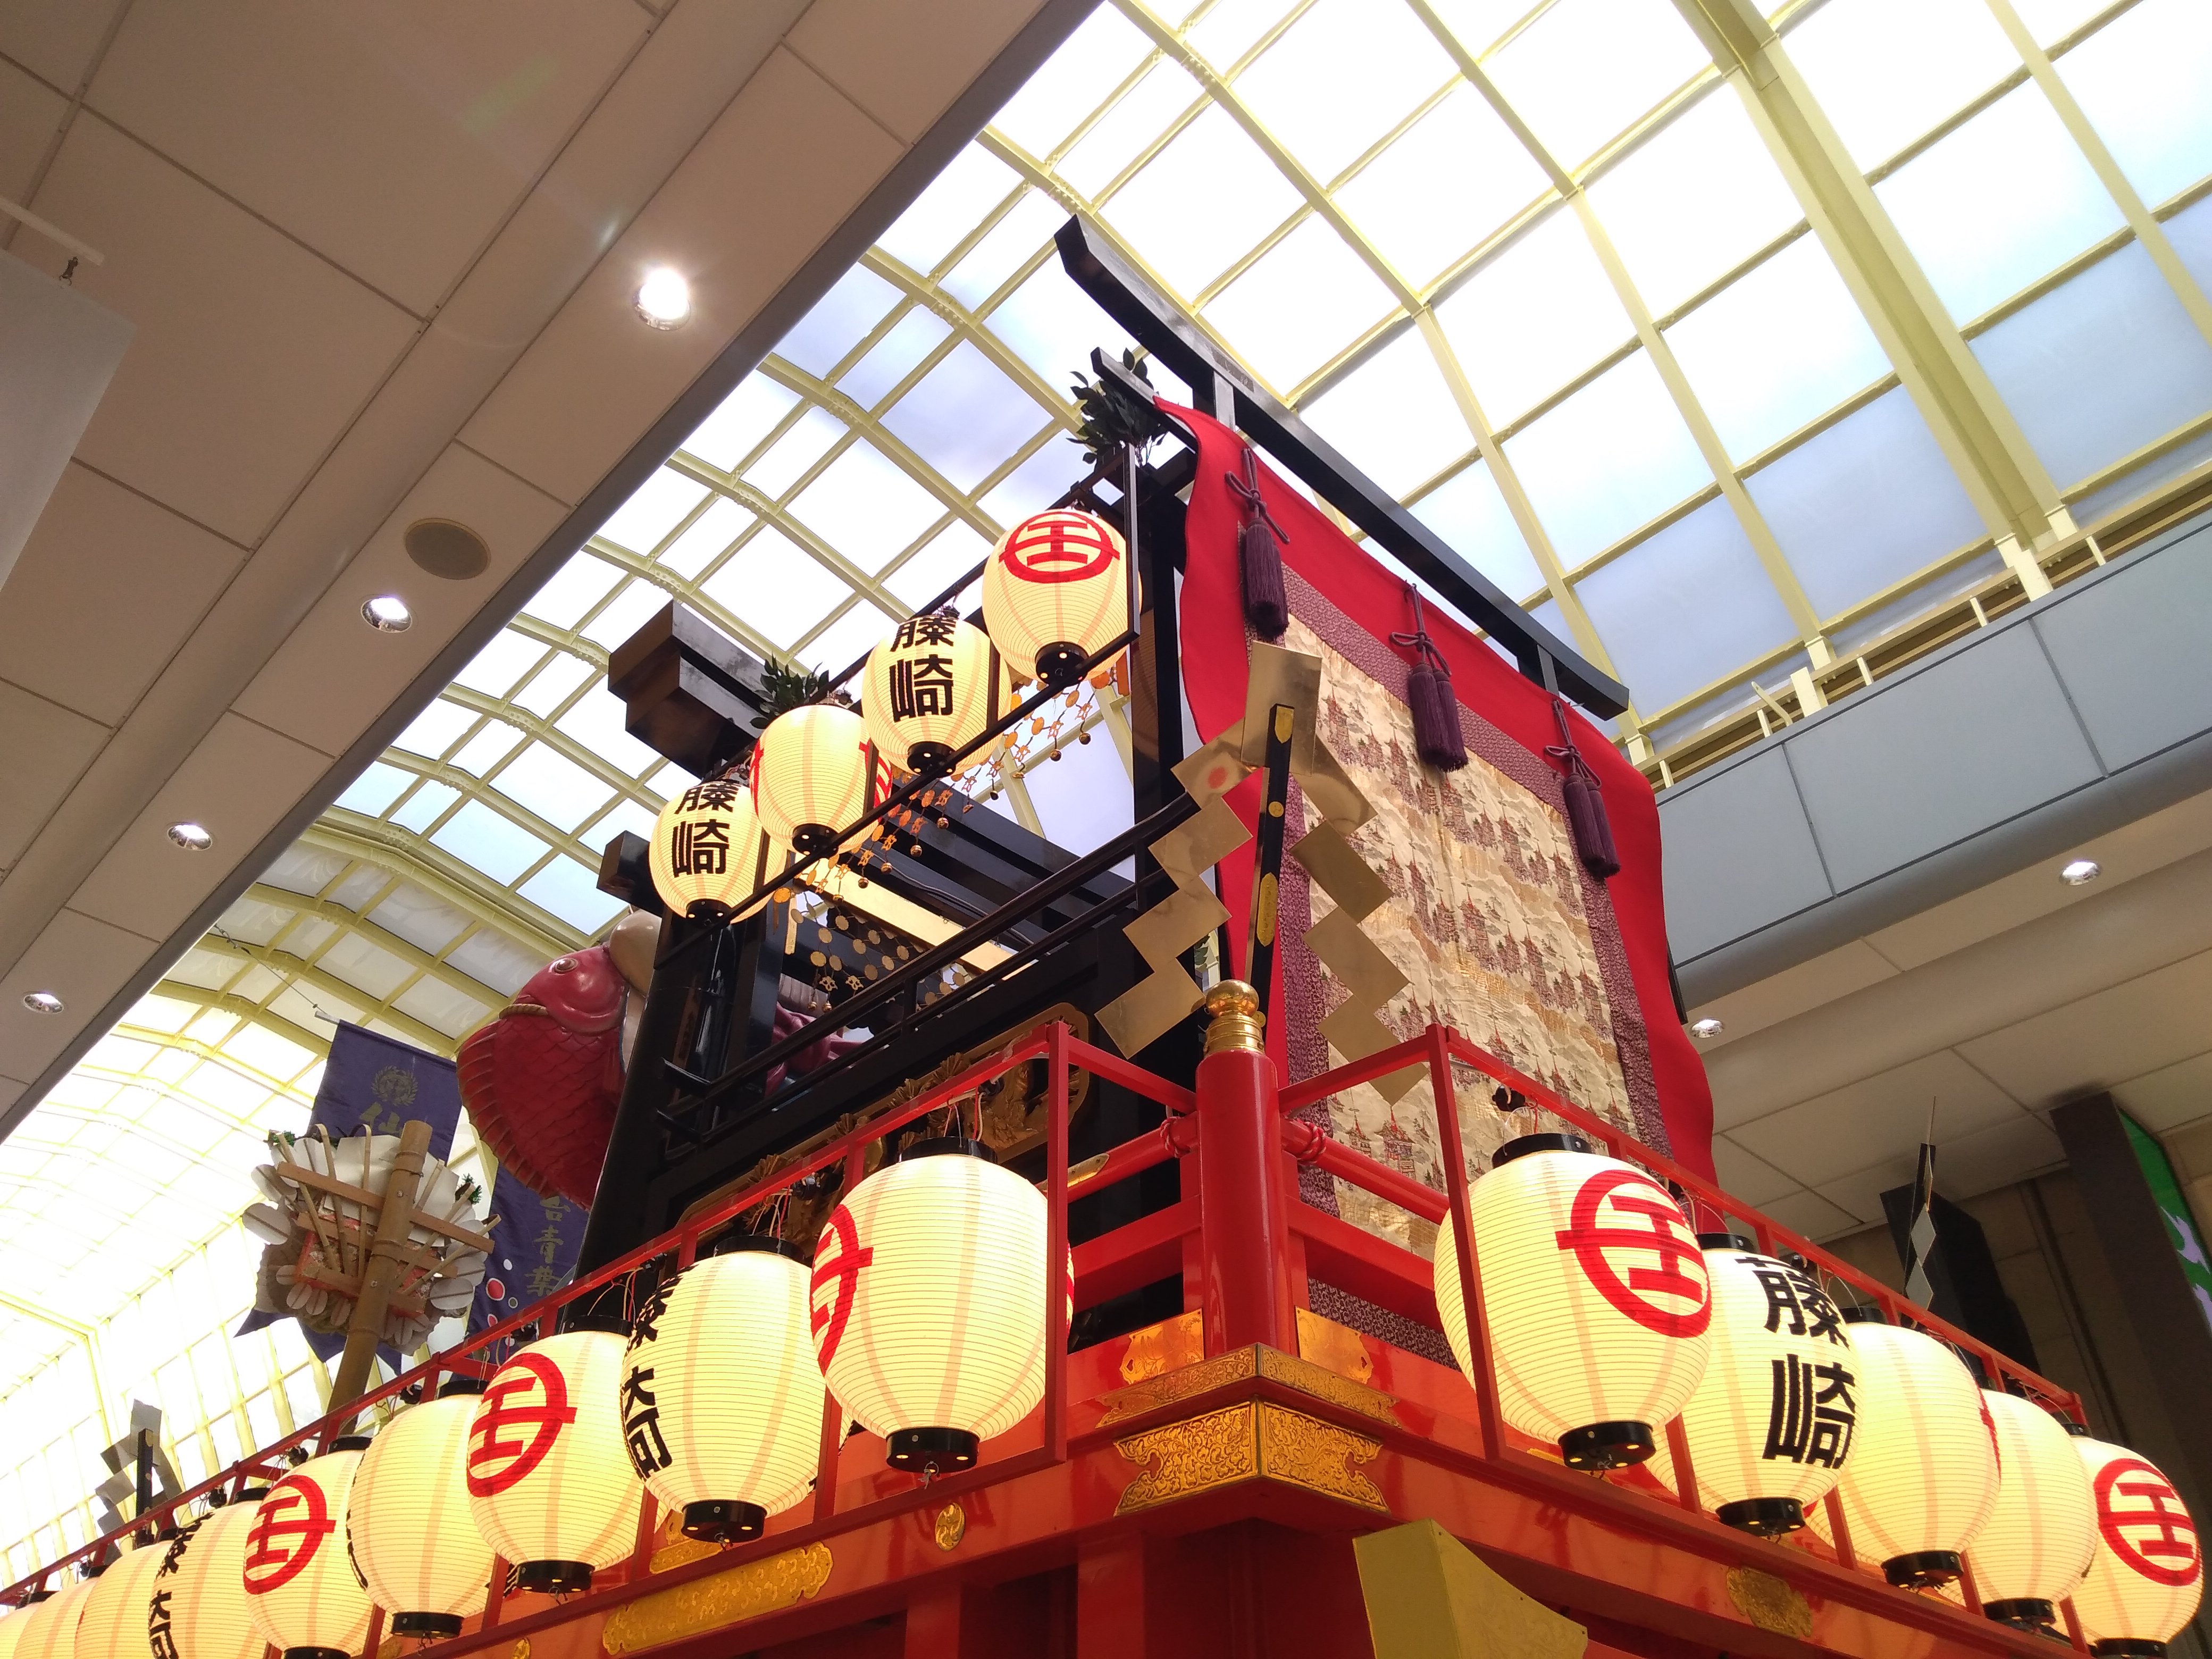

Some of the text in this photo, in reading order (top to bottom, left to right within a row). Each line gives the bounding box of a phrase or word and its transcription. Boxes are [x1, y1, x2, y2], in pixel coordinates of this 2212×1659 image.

[889, 614, 957, 723] 藤崎
[671, 778, 742, 878] 藤崎
[1734, 1255, 1856, 1470] 藤崎
